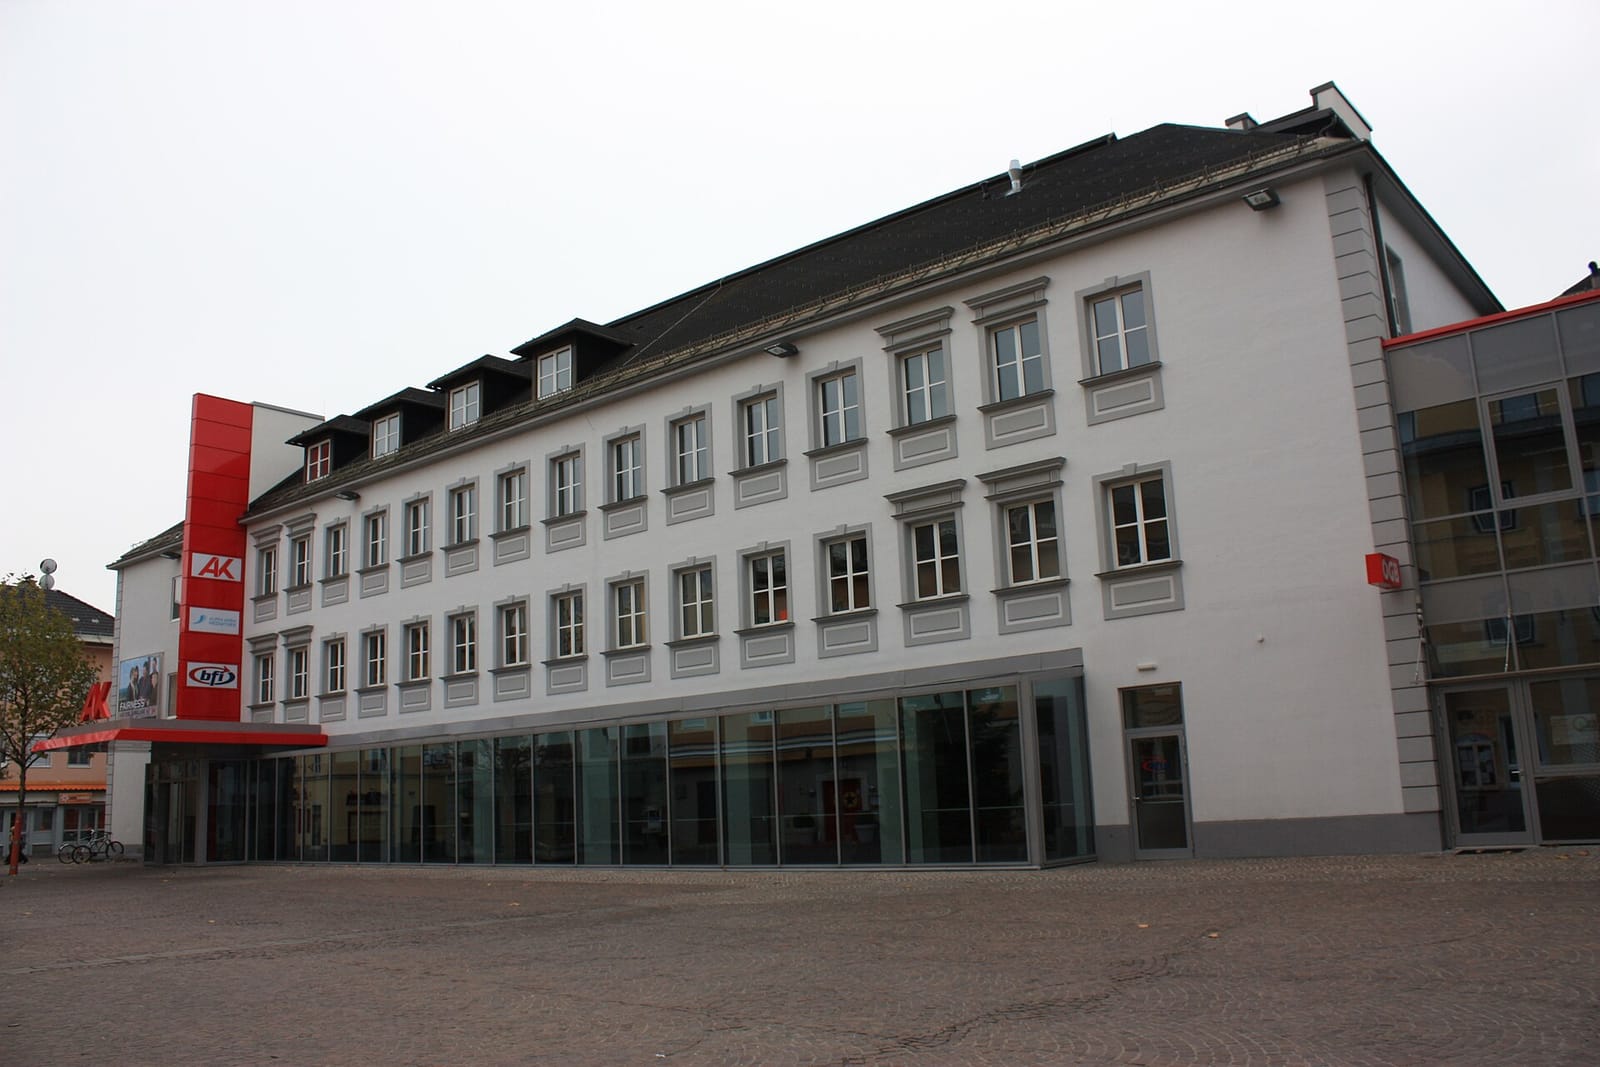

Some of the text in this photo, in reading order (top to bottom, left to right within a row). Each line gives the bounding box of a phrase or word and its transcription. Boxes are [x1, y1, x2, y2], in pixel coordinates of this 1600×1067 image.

[198, 557, 235, 579] AK
[200, 670, 225, 686] bfi
[81, 681, 113, 721] AK
